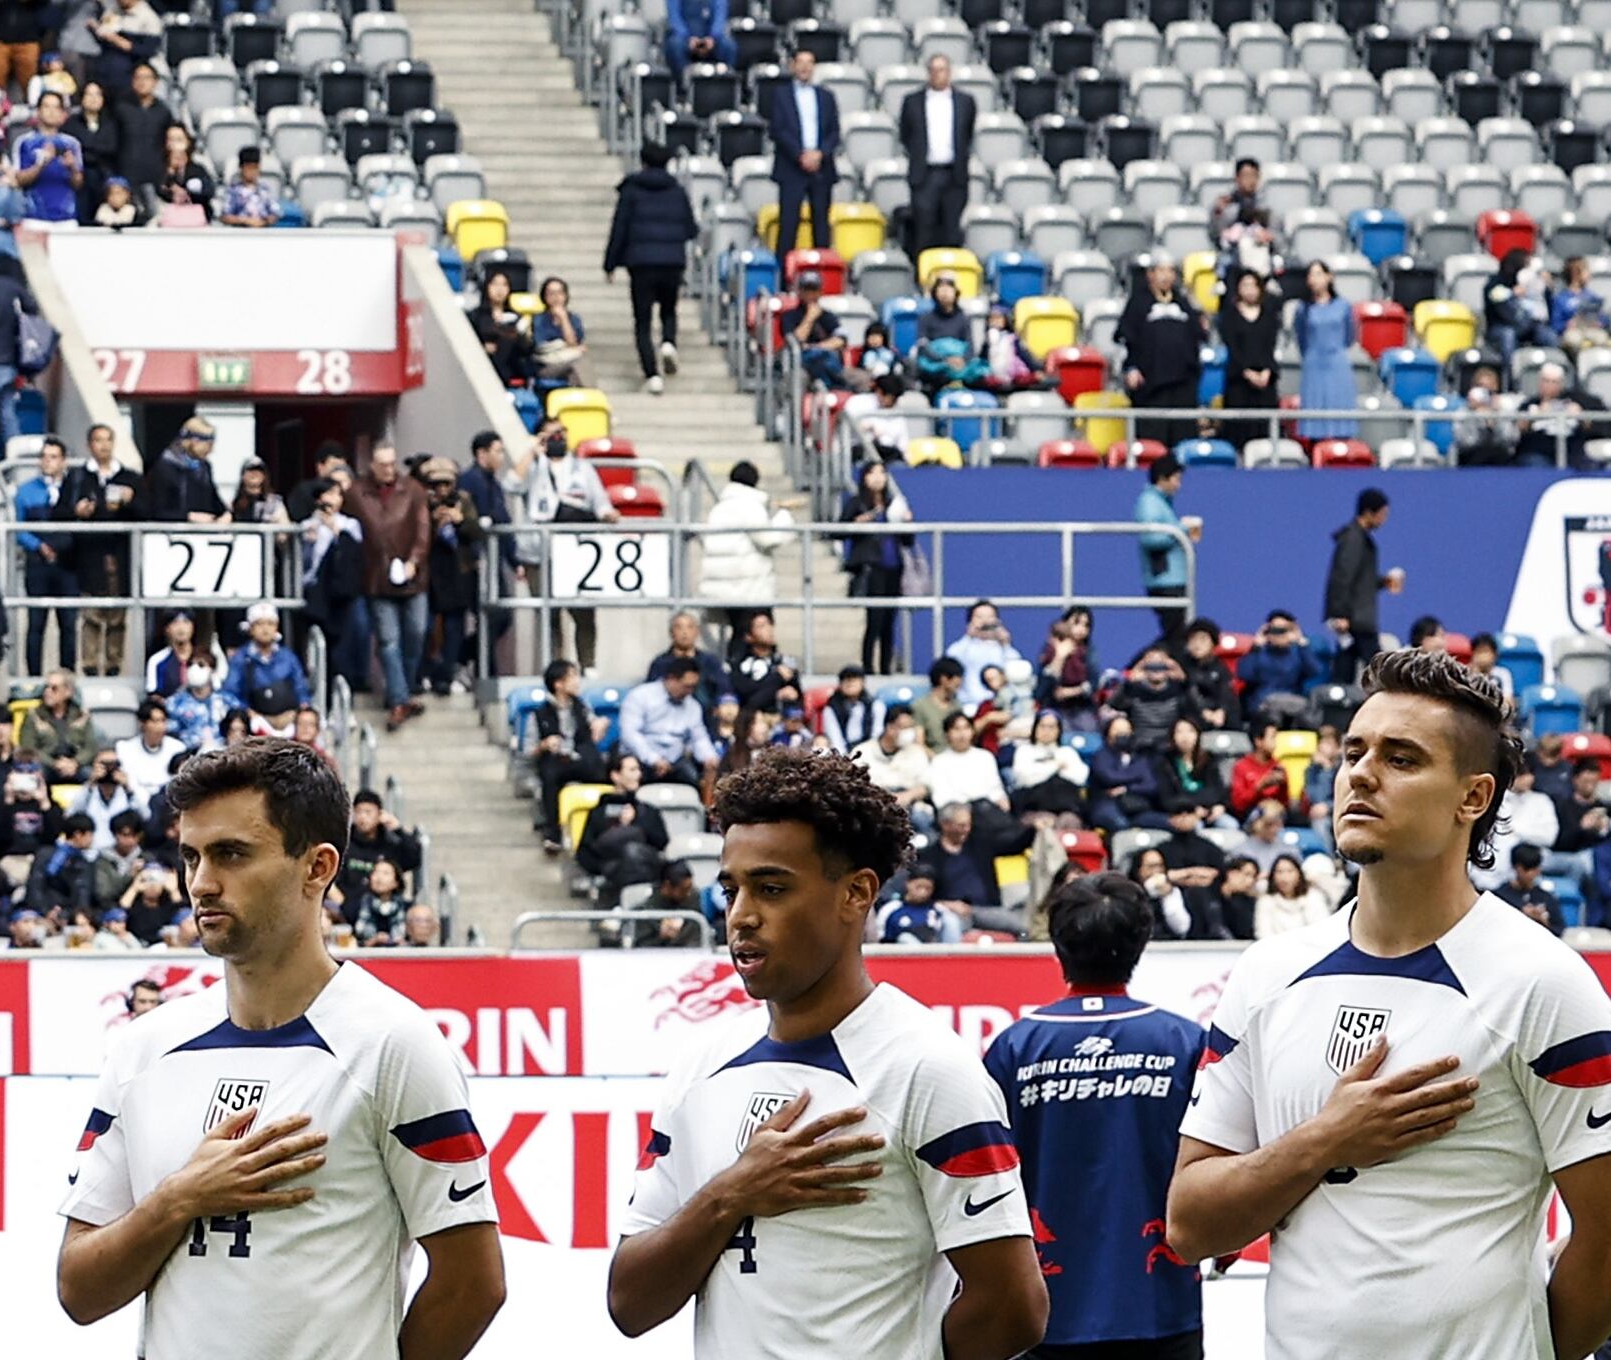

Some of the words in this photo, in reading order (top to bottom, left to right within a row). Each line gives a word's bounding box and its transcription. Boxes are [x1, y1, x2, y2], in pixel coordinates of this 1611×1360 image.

[94, 350, 145, 392] 27
[296, 350, 352, 394] 28
[168, 540, 234, 592] 27
[577, 540, 644, 591] 28
[1339, 1011, 1386, 1038] USA
[1058, 1053, 1144, 1074] CHALLENGE
[1145, 1053, 1176, 1071] CUP
[218, 1084, 262, 1110] USA
